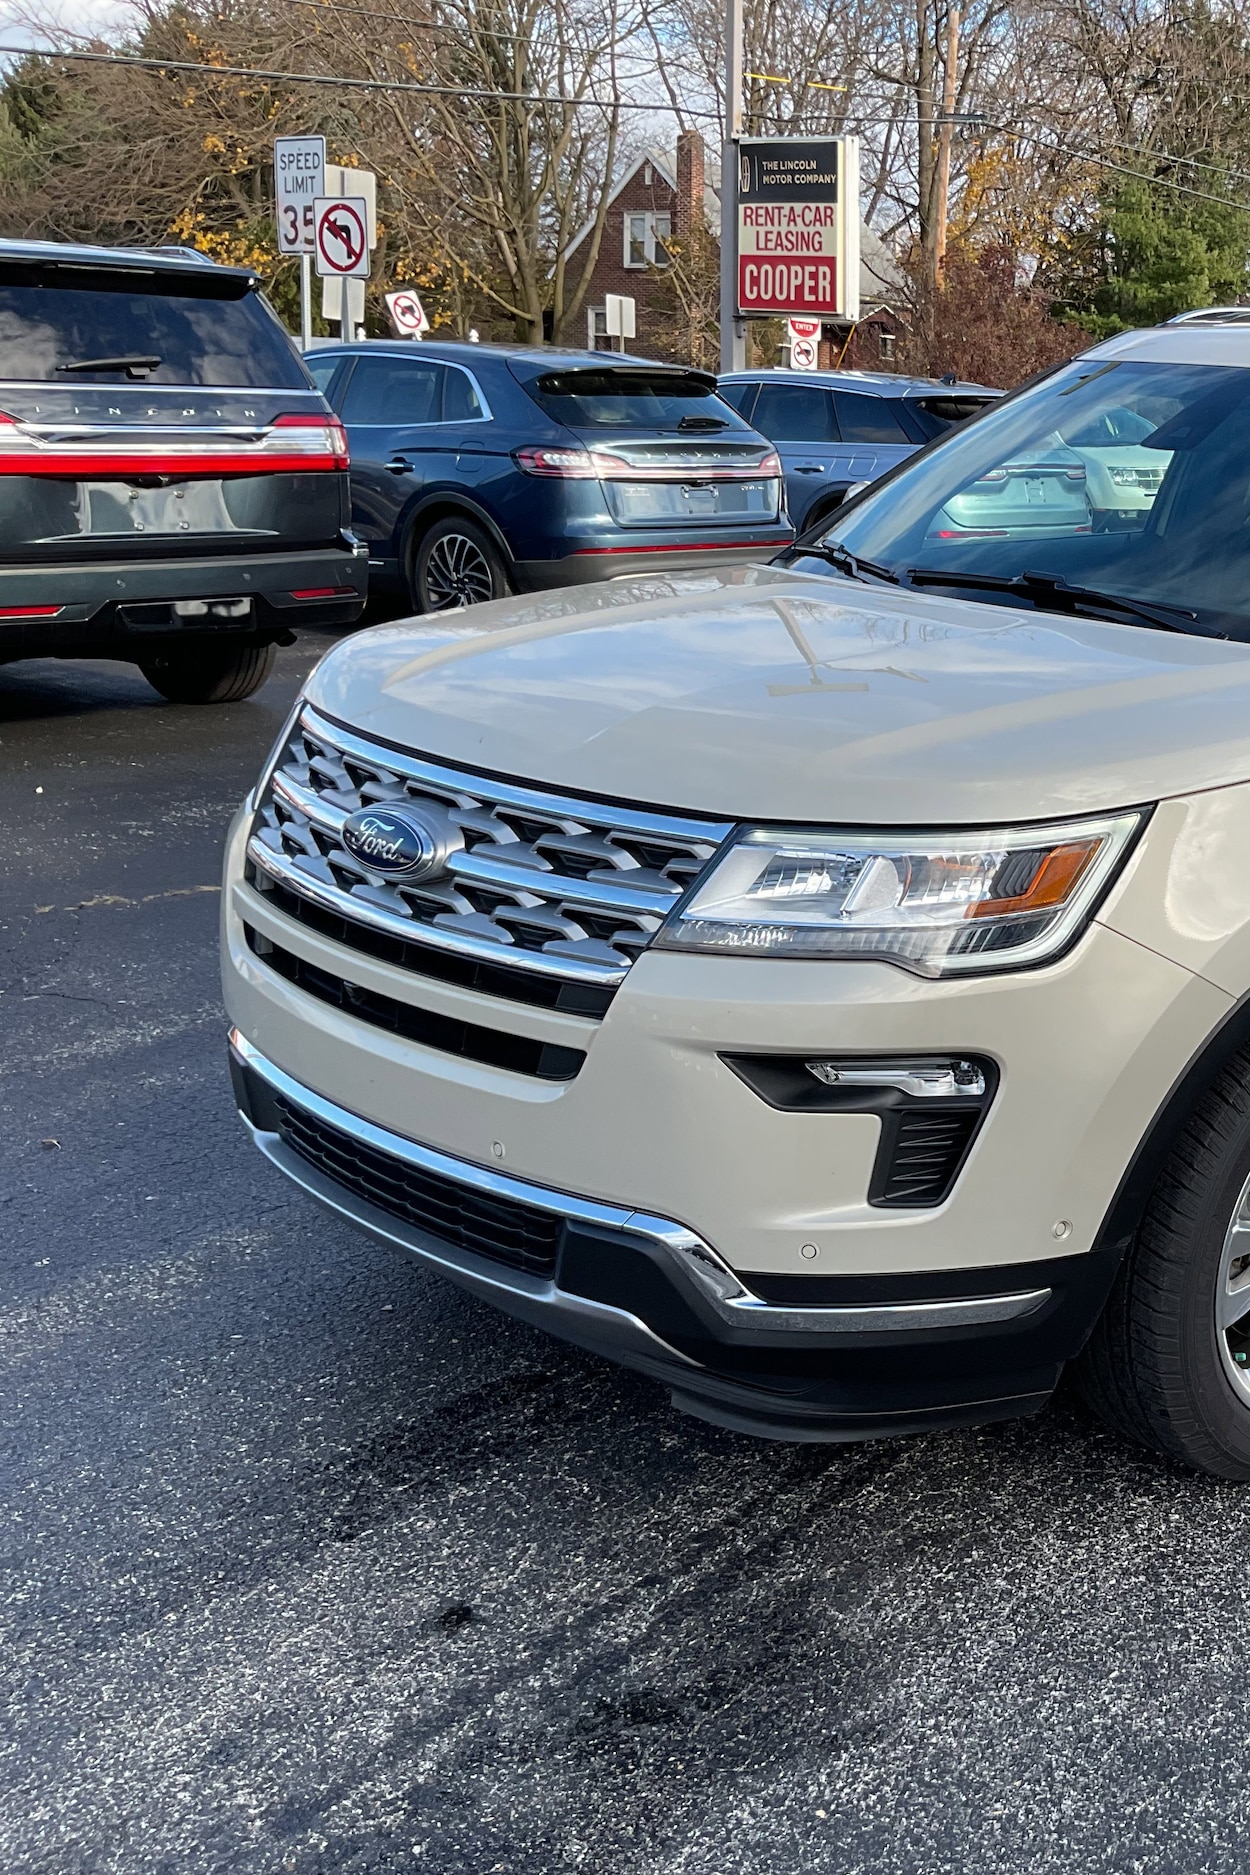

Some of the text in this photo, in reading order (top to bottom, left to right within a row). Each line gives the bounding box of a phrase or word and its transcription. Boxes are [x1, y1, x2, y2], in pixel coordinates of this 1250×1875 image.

[280, 152, 320, 170] SPEED
[762, 160, 817, 170] THE LINCOLN
[284, 176, 316, 193] LIMIT
[763, 174, 836, 184] MOTOR COMPANY
[284, 204, 314, 245] 35
[743, 205, 834, 227] RENT-A-CAR
[756, 230, 823, 252] LEASING
[745, 264, 831, 302] COOPER
[795, 322, 814, 332] ENTER
[358, 817, 404, 861] Ford
